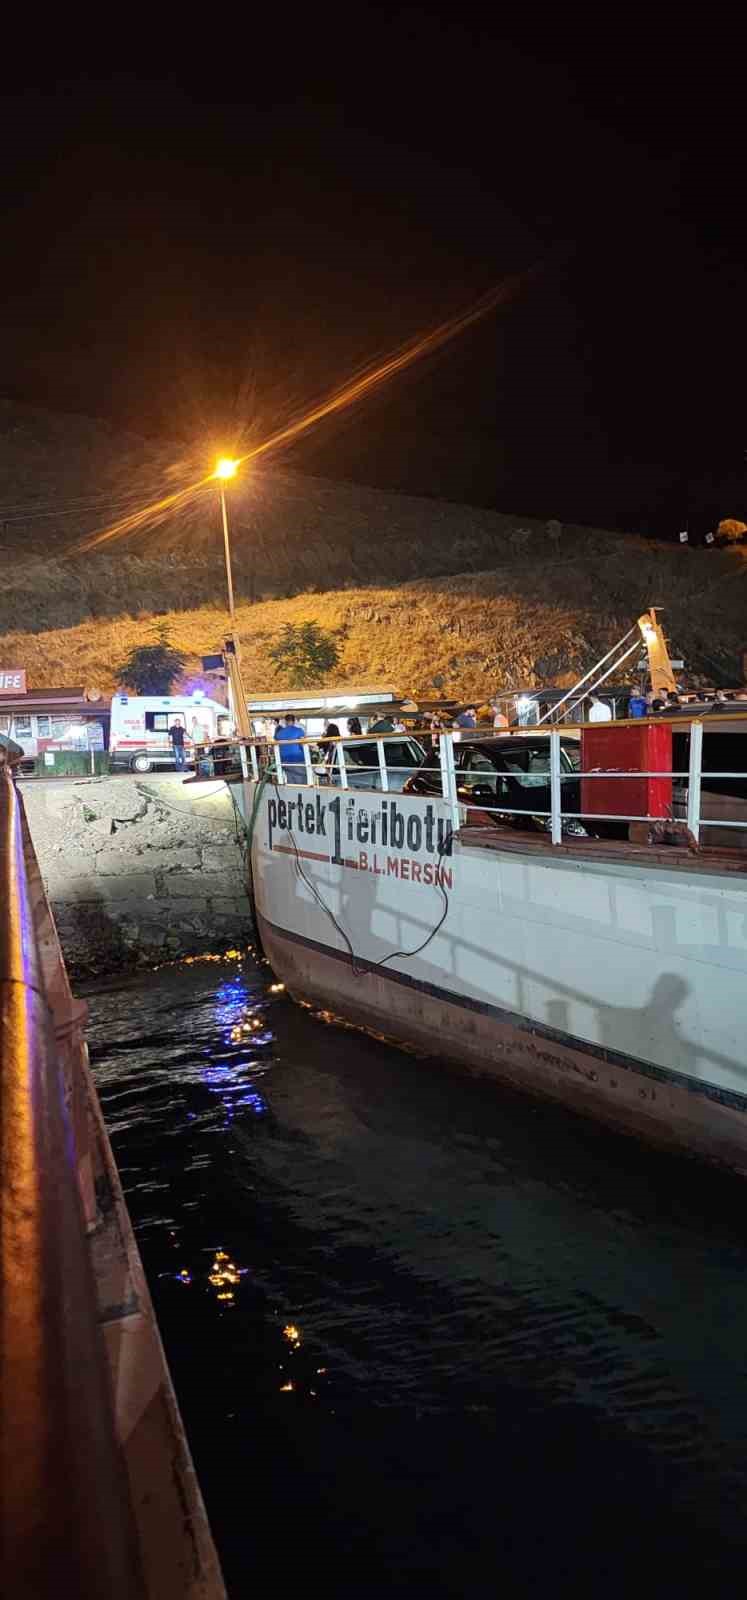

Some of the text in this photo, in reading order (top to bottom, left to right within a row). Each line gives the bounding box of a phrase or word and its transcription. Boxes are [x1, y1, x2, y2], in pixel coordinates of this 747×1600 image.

[267, 794, 453, 865] pertek 1 feribotu
